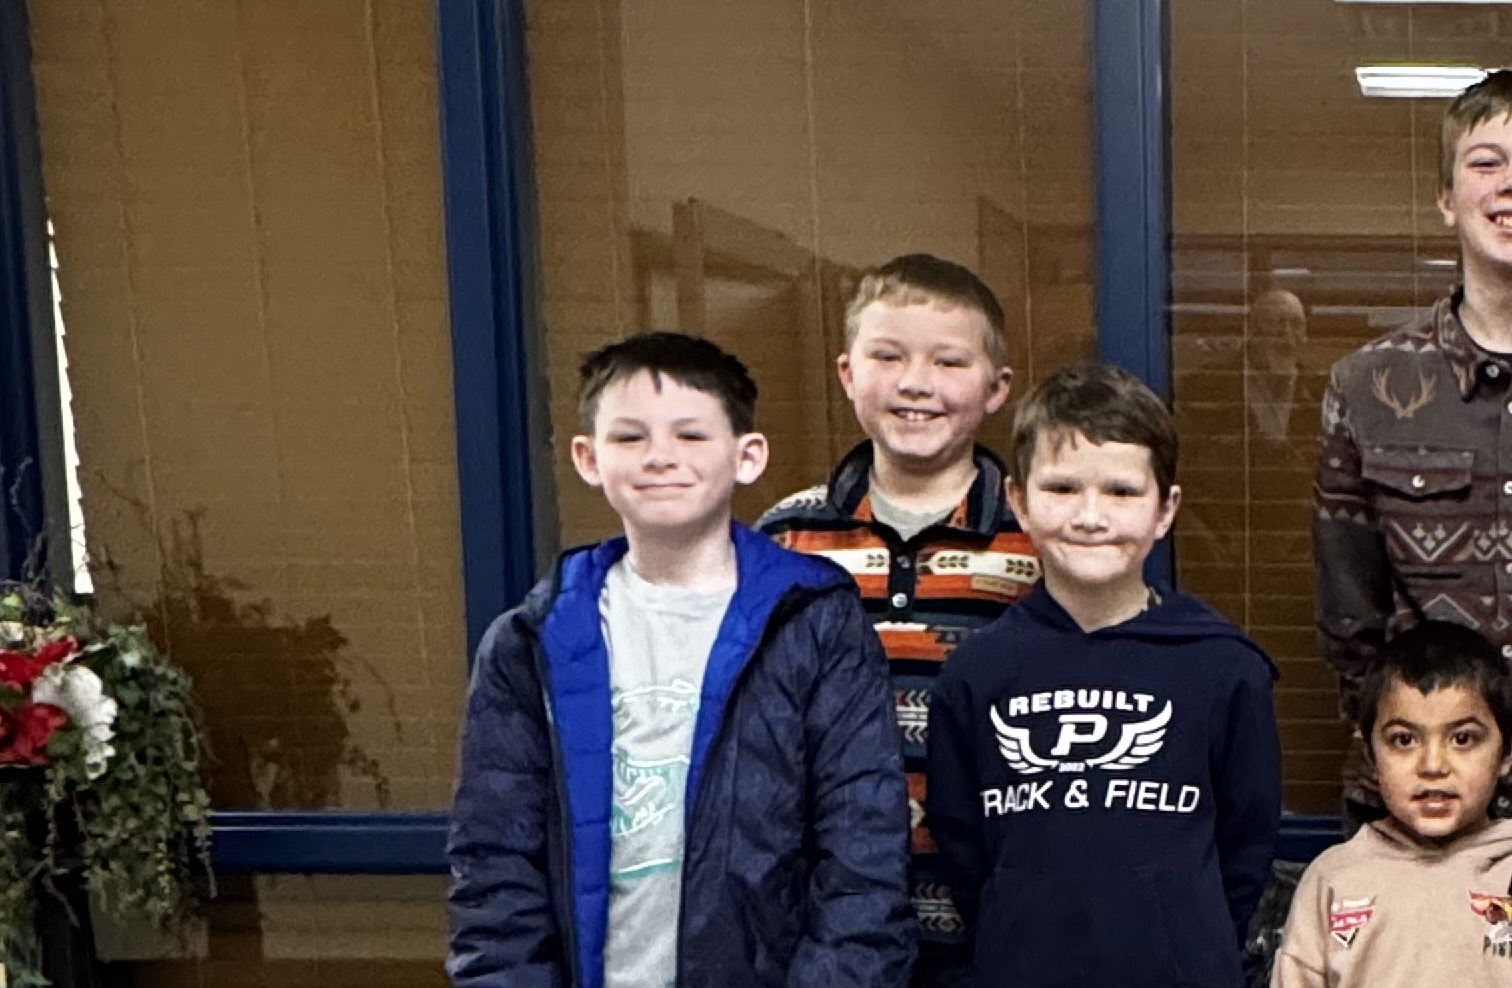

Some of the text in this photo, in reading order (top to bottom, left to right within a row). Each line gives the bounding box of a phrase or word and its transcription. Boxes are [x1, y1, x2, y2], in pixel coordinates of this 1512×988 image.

[1009, 689, 1155, 717] REBUILT
[1050, 714, 1108, 756] P
[980, 779, 1200, 818] RACK & FIELD
